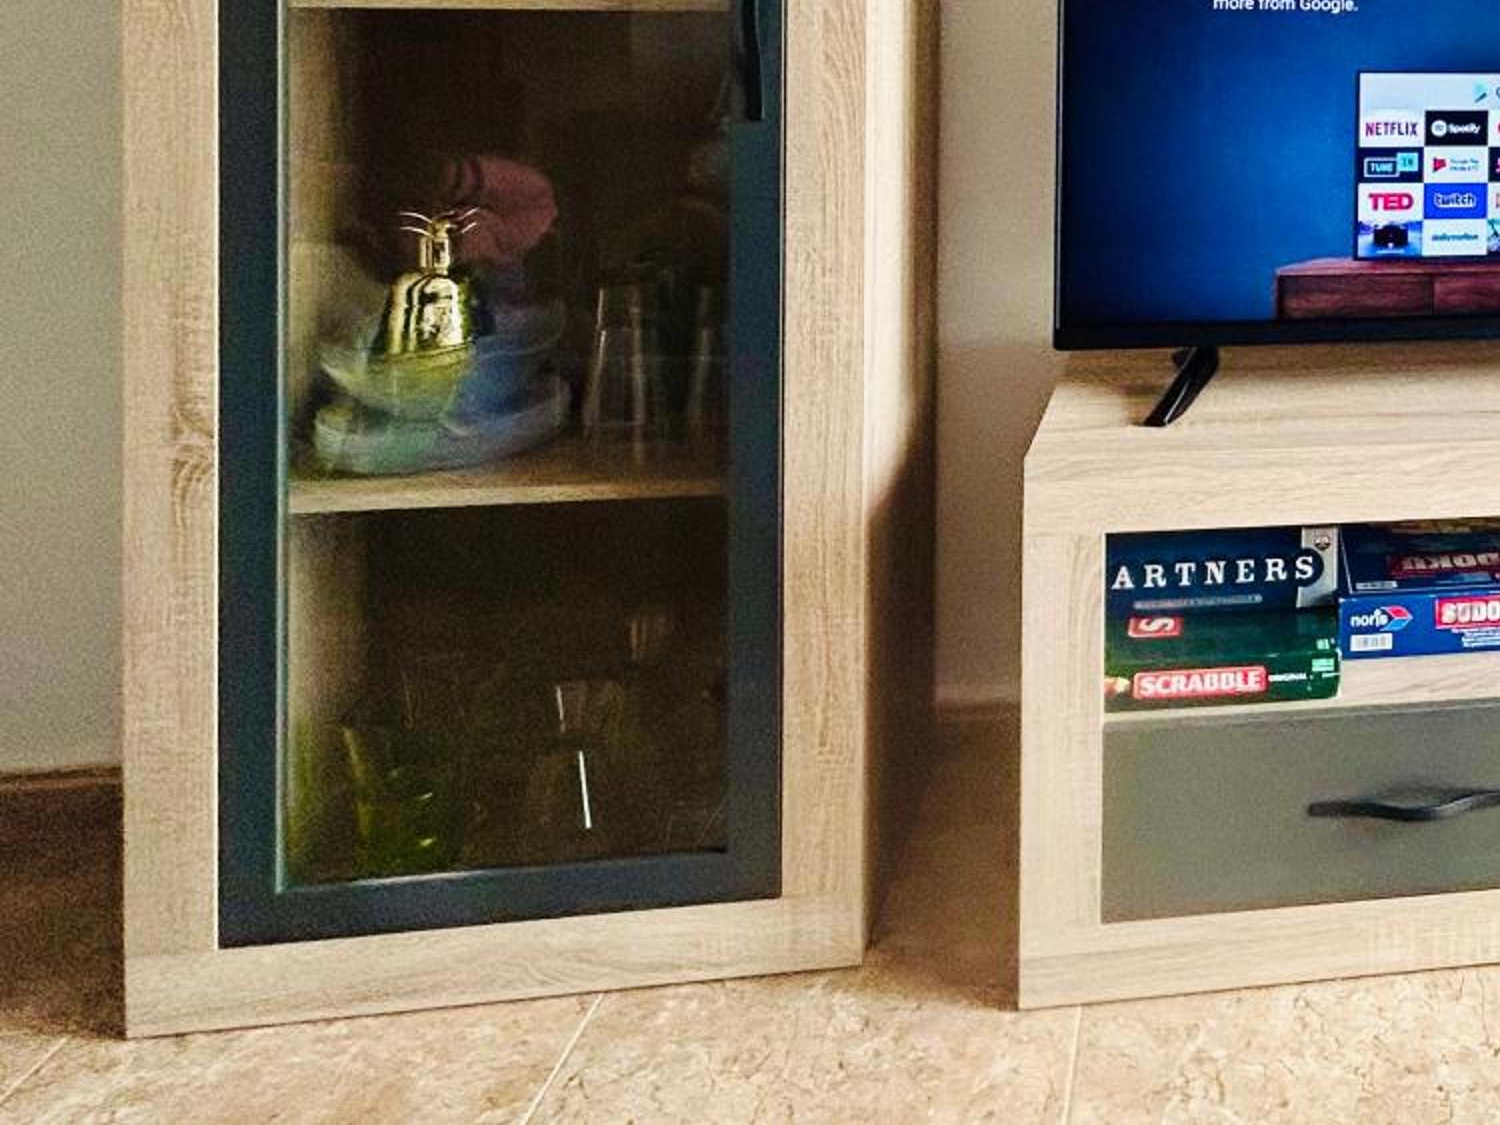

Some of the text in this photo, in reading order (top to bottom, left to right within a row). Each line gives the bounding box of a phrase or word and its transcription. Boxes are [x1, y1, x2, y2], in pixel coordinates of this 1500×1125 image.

[1365, 122, 1418, 137] NETFLIX
[1449, 123, 1481, 134] Spotify
[1369, 192, 1414, 211] TED
[1433, 192, 1477, 209] twitch
[1350, 608, 1389, 627] noris
[1141, 671, 1262, 695] SCRABBLE
